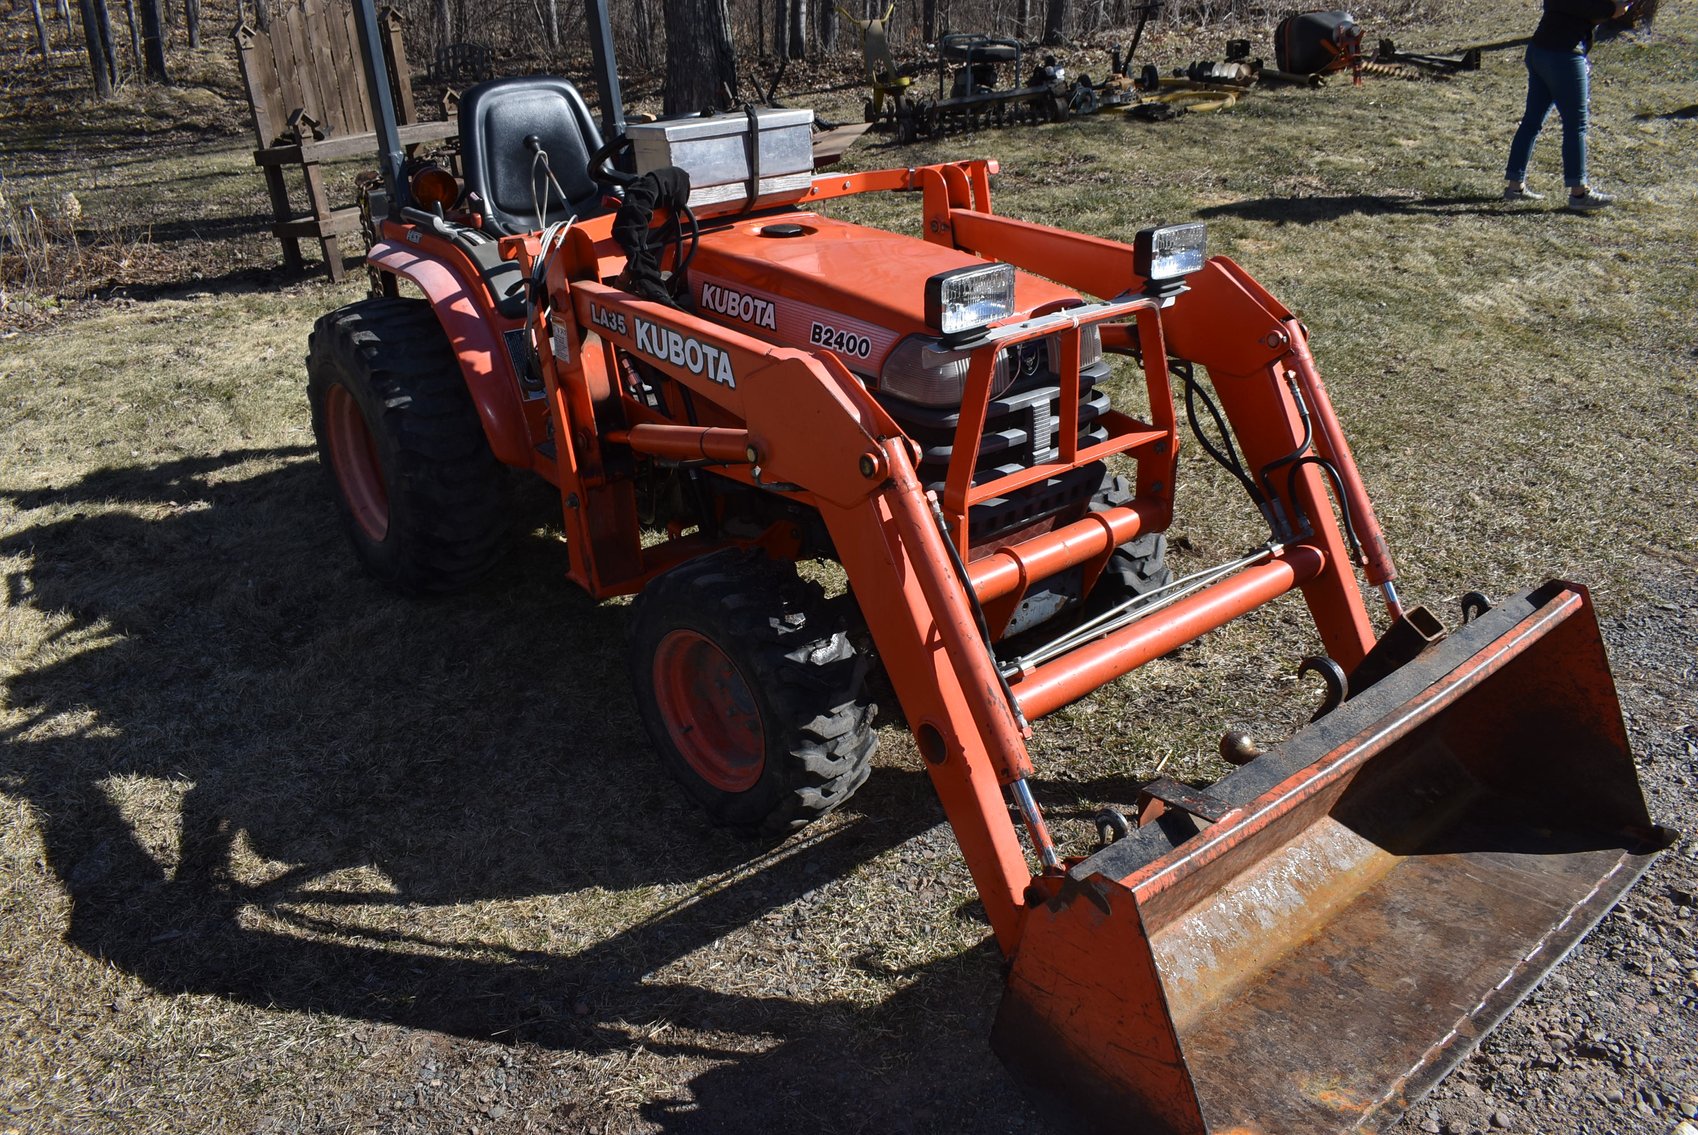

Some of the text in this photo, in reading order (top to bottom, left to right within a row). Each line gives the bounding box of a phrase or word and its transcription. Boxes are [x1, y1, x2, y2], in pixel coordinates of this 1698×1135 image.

[701, 282, 777, 331] KUBOTA
[590, 303, 736, 388] LA35 KUBOTA
[810, 321, 871, 359] B2400
